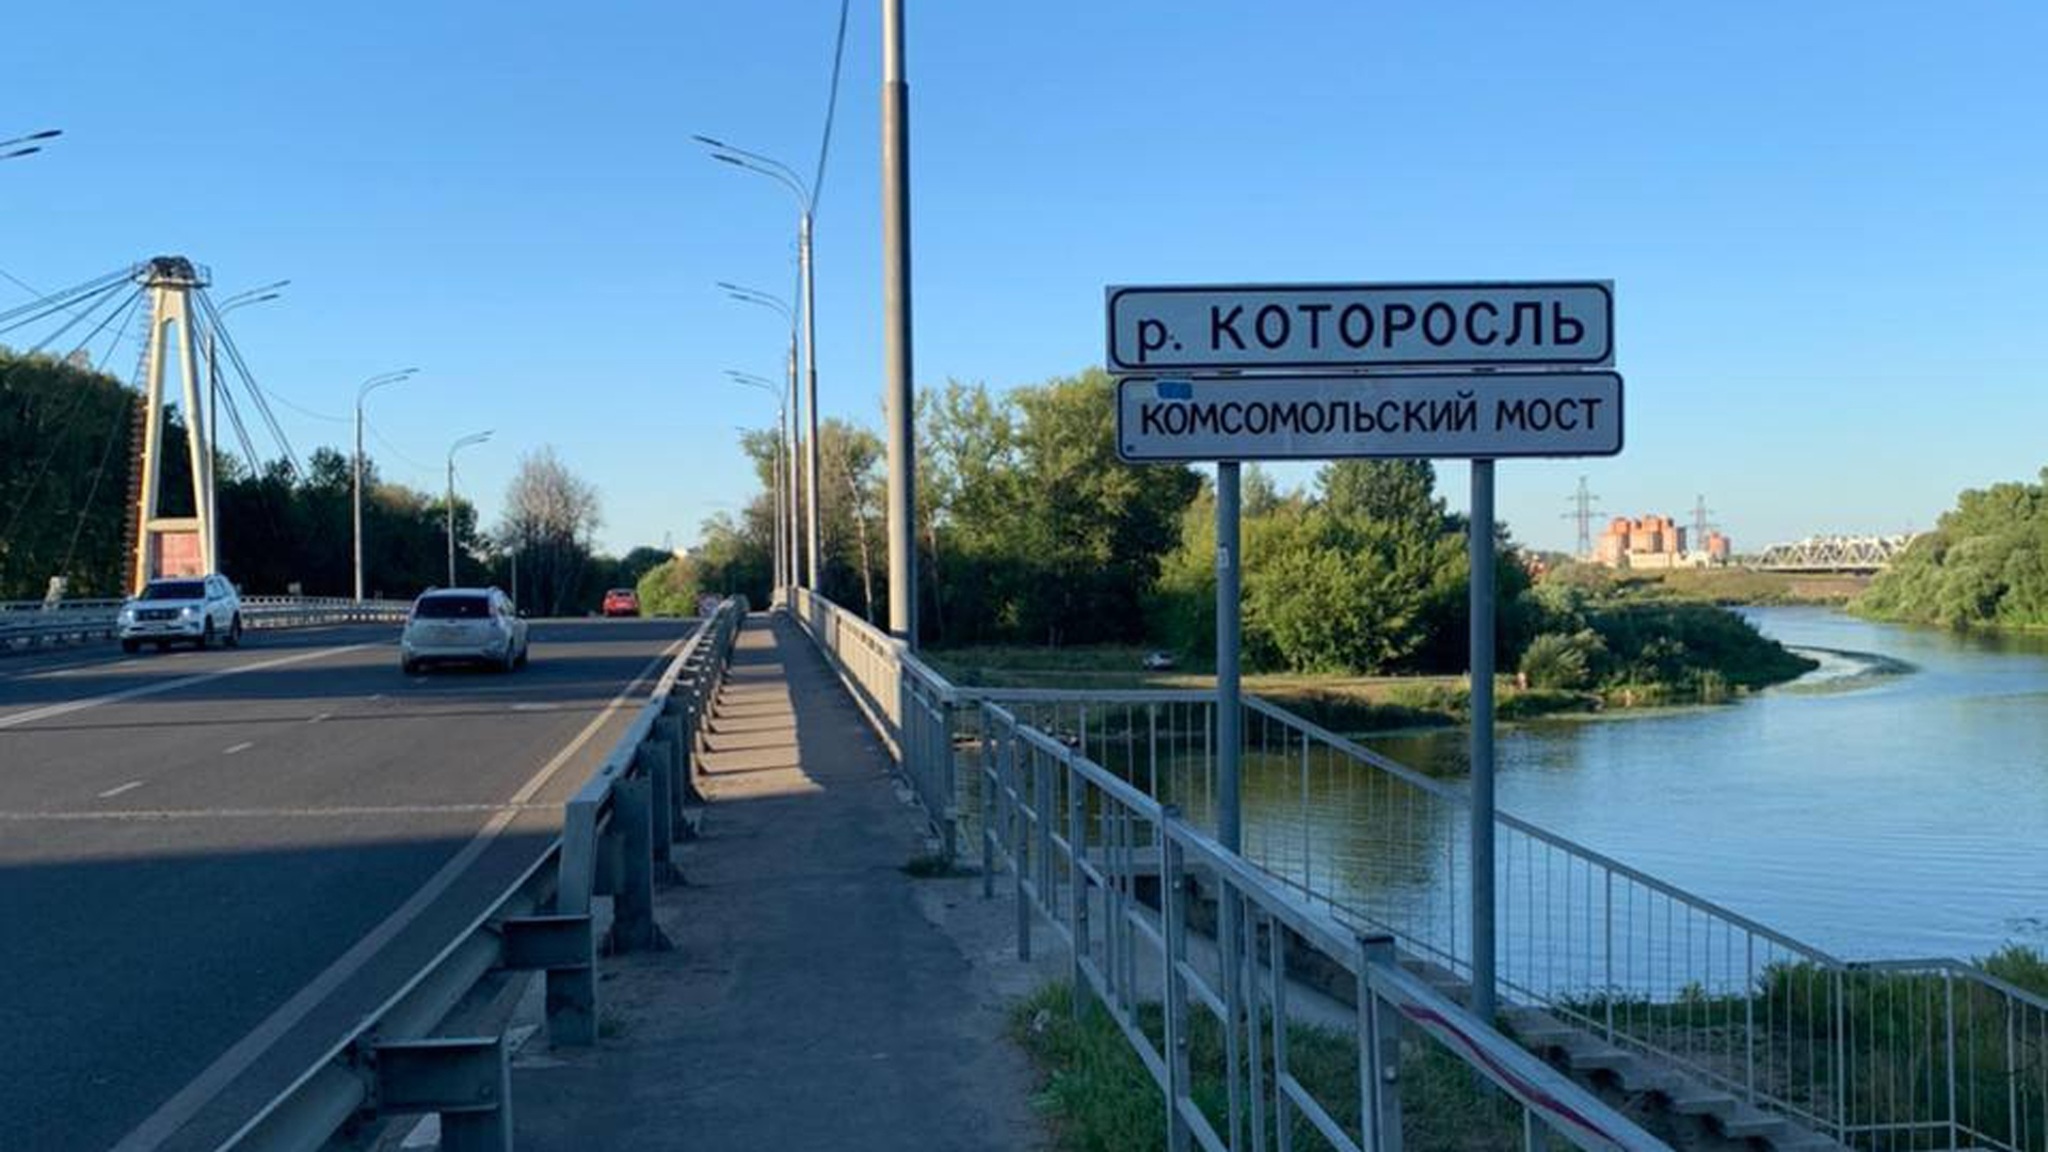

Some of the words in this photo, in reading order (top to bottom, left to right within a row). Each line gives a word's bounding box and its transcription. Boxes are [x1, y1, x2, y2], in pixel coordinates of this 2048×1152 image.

[1137, 318, 1183, 363] р.
[1210, 301, 1585, 350] КОТОРОСЛЬ
[1141, 390, 1477, 435] КОМСОМОЛЬСКИЙ
[1496, 397, 1603, 432] МОСТ
